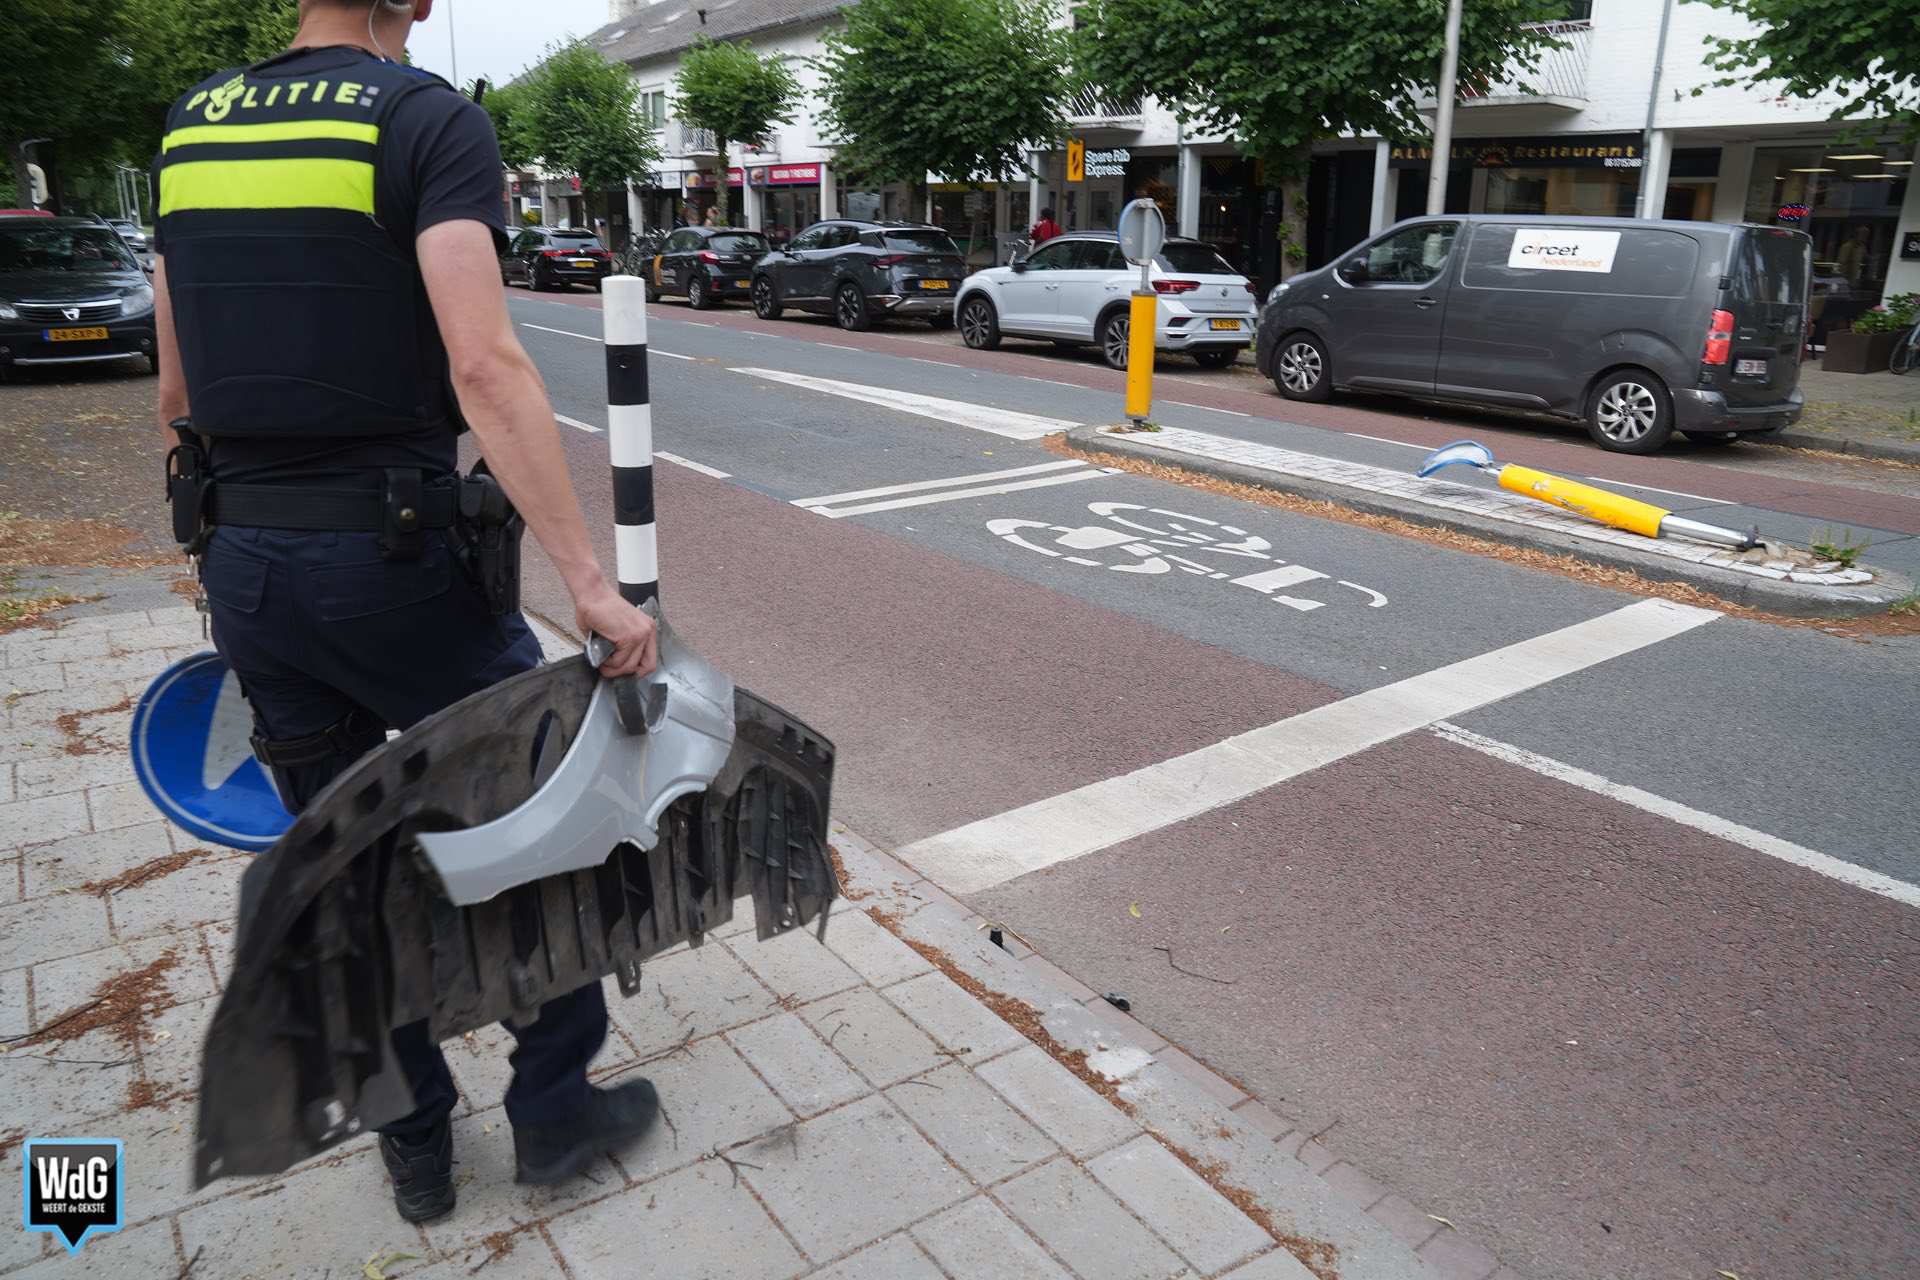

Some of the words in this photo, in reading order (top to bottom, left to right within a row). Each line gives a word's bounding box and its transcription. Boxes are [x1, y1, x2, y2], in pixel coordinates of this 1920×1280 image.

[1085, 150, 1112, 163] Spare
[1113, 149, 1130, 162] Rib
[1514, 145, 1636, 159] Restaurant
[1521, 243, 1579, 256] circet
[1541, 256, 1602, 267] Nederland
